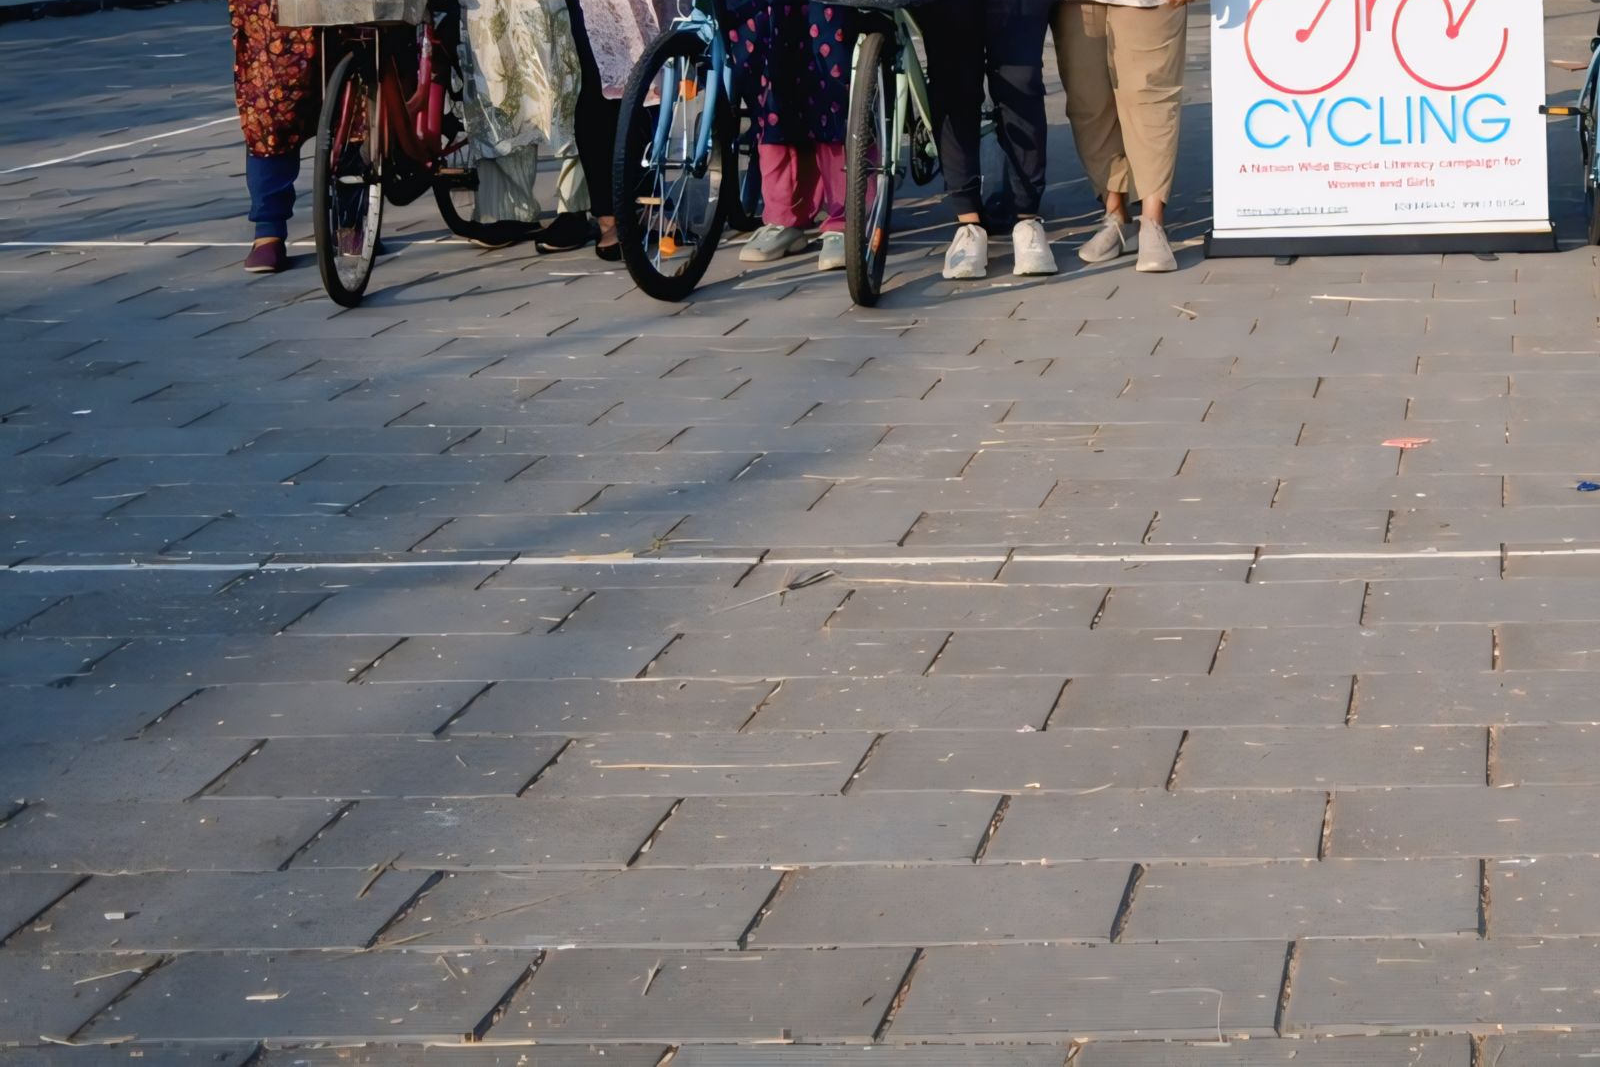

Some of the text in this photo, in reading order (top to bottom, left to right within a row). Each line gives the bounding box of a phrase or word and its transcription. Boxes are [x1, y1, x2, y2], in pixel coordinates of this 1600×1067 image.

[1244, 93, 1512, 149] CYCLING
[1239, 164, 1247, 173] A
[1384, 160, 1435, 171] Literacy
[1504, 156, 1522, 166] for
[1379, 178, 1402, 188] and
[1406, 176, 1436, 188] Girls
